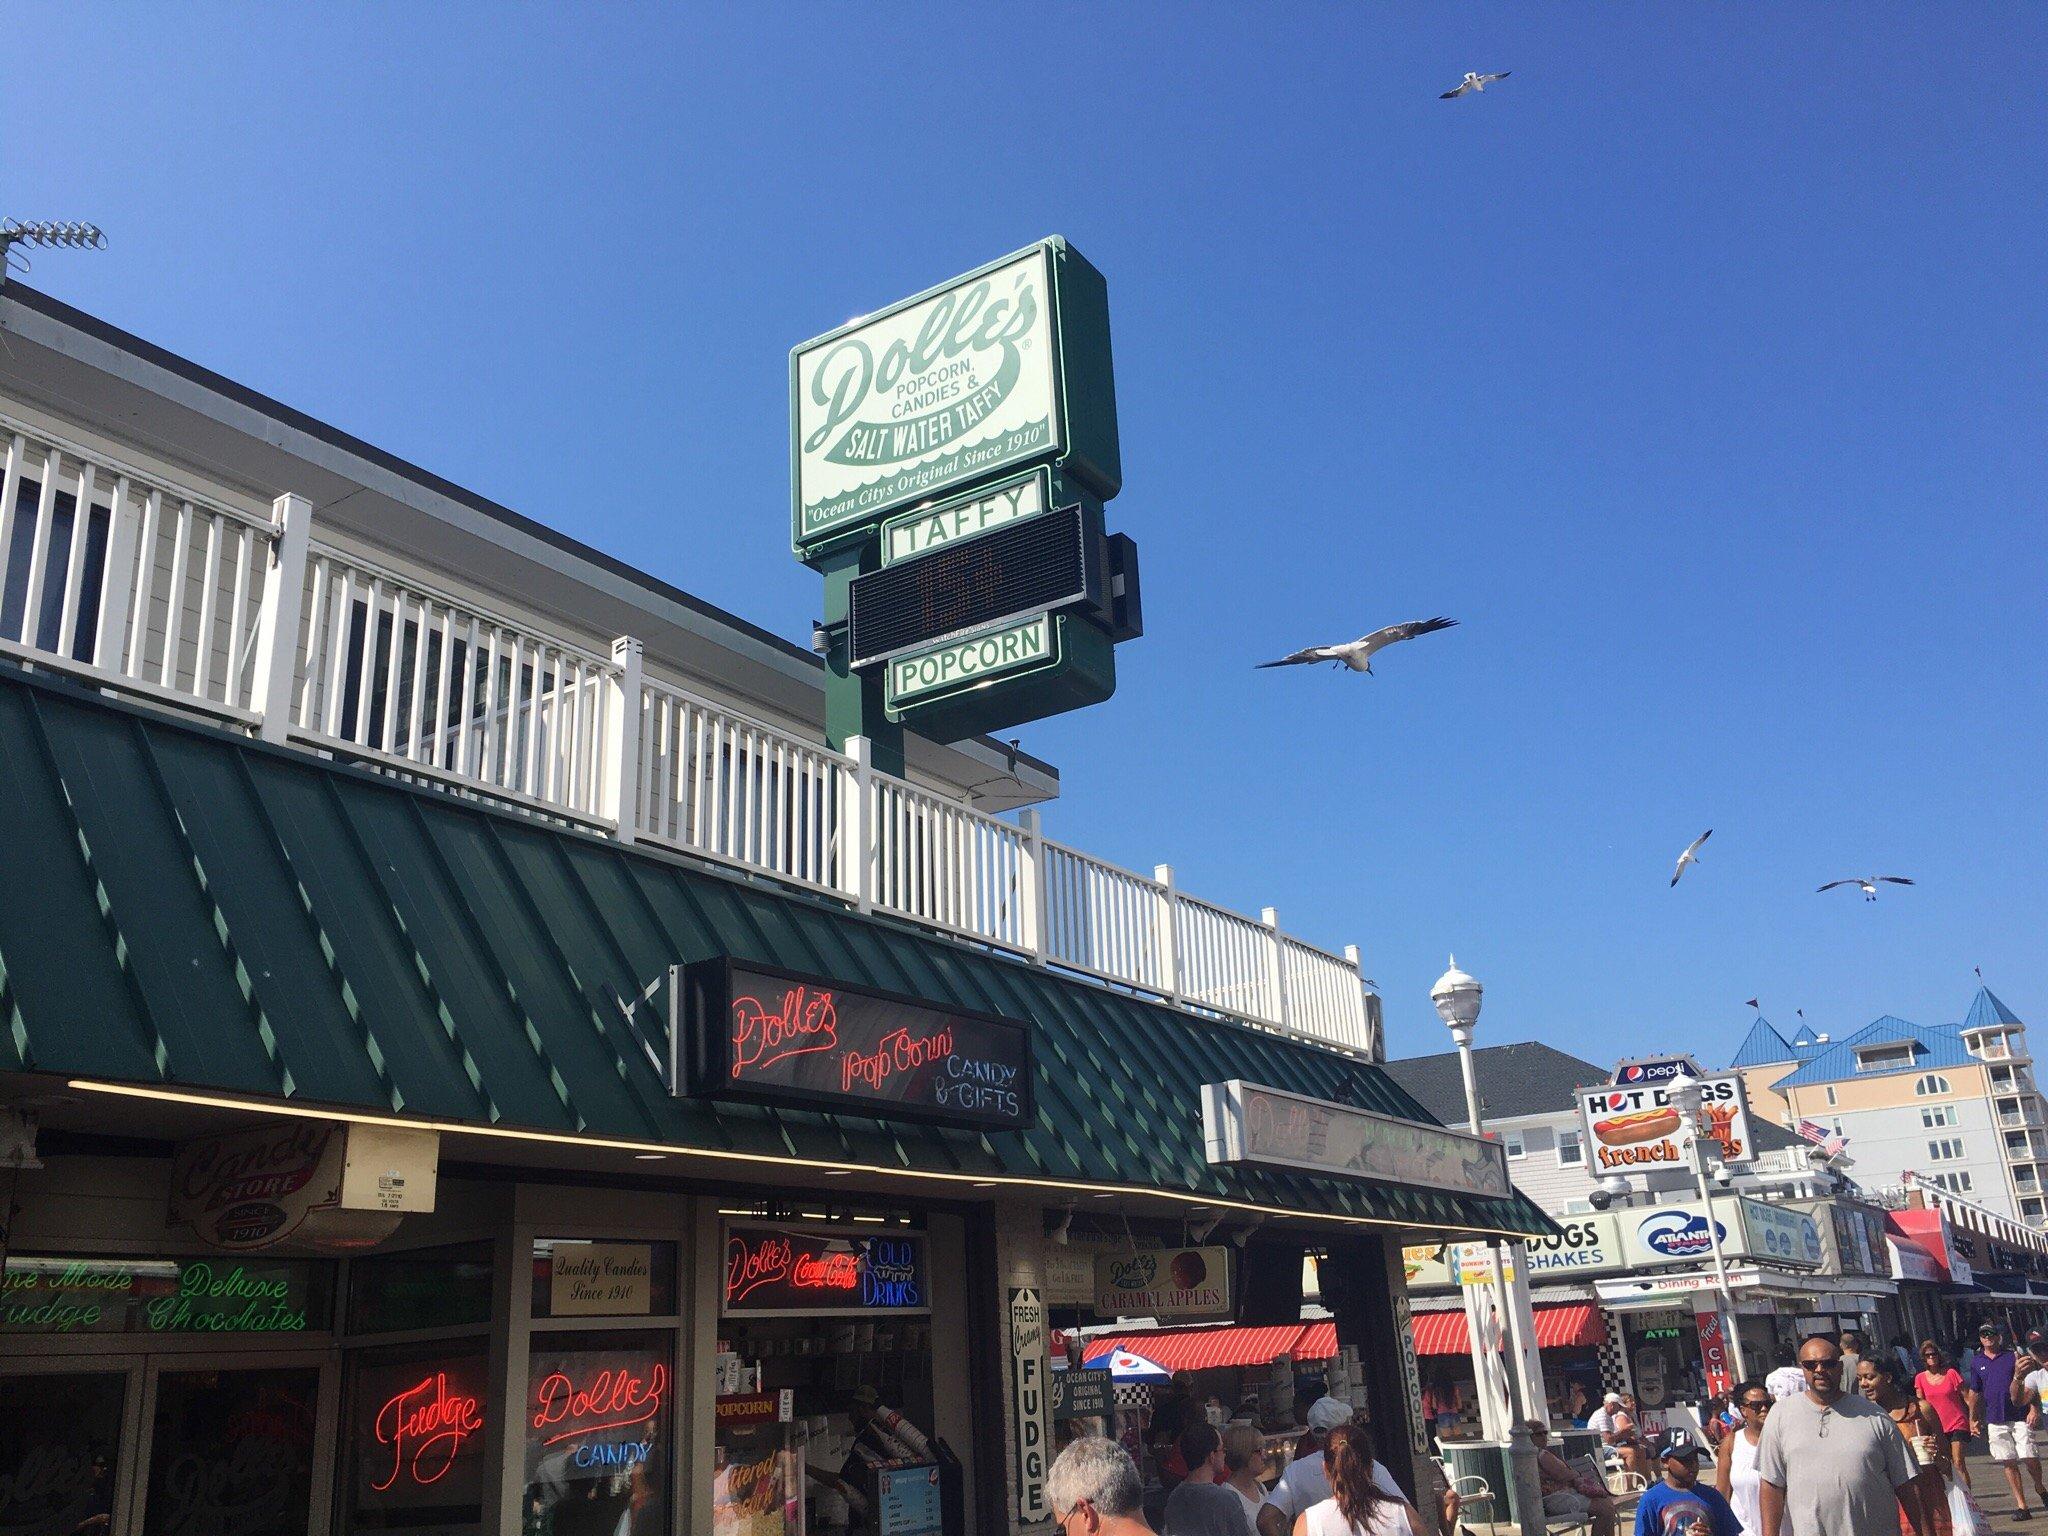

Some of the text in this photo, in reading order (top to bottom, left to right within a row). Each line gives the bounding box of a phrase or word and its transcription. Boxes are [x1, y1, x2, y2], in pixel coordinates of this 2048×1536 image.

[804, 272, 1037, 453] Dolle's
[897, 358, 975, 399] POPCORN,
[892, 375, 980, 418] CANDIES &
[845, 380, 1003, 460] SALT WATER TAFFY
[897, 459, 959, 490] Original
[962, 444, 1002, 469] Since
[902, 484, 1027, 553] TAFFY
[901, 625, 1041, 692] POPCORN
[946, 1054, 1017, 1088] CANDY
[958, 1082, 1019, 1117] GIFTS
[1653, 1082, 1734, 1107] DGS
[1598, 1139, 1680, 1170] french
[1526, 1222, 1599, 1253] DOGS
[1654, 1230, 1722, 1245] ATLANTI
[50, 1262, 134, 1290] Made
[555, 1256, 647, 1284] Quality Candies
[1526, 1249, 1604, 1270] SHAKES
[181, 1263, 288, 1298] Deluxe
[571, 1281, 603, 1301] Since
[1657, 1275, 1742, 1289] Dining Rom
[0, 1288, 101, 1333] udge
[149, 1299, 307, 1332] Chocolates
[1014, 1306, 1040, 1323] FRESH
[1101, 1289, 1221, 1310] CARAMEL APPLES
[1014, 1325, 1041, 1356] Creamy
[1645, 1328, 1680, 1340] ATM
[1403, 1335, 1426, 1446] POPCORN
[372, 1374, 482, 1490] Fudge
[1022, 1359, 1043, 1511] FUDGE
[576, 1442, 653, 1468] CANDY
